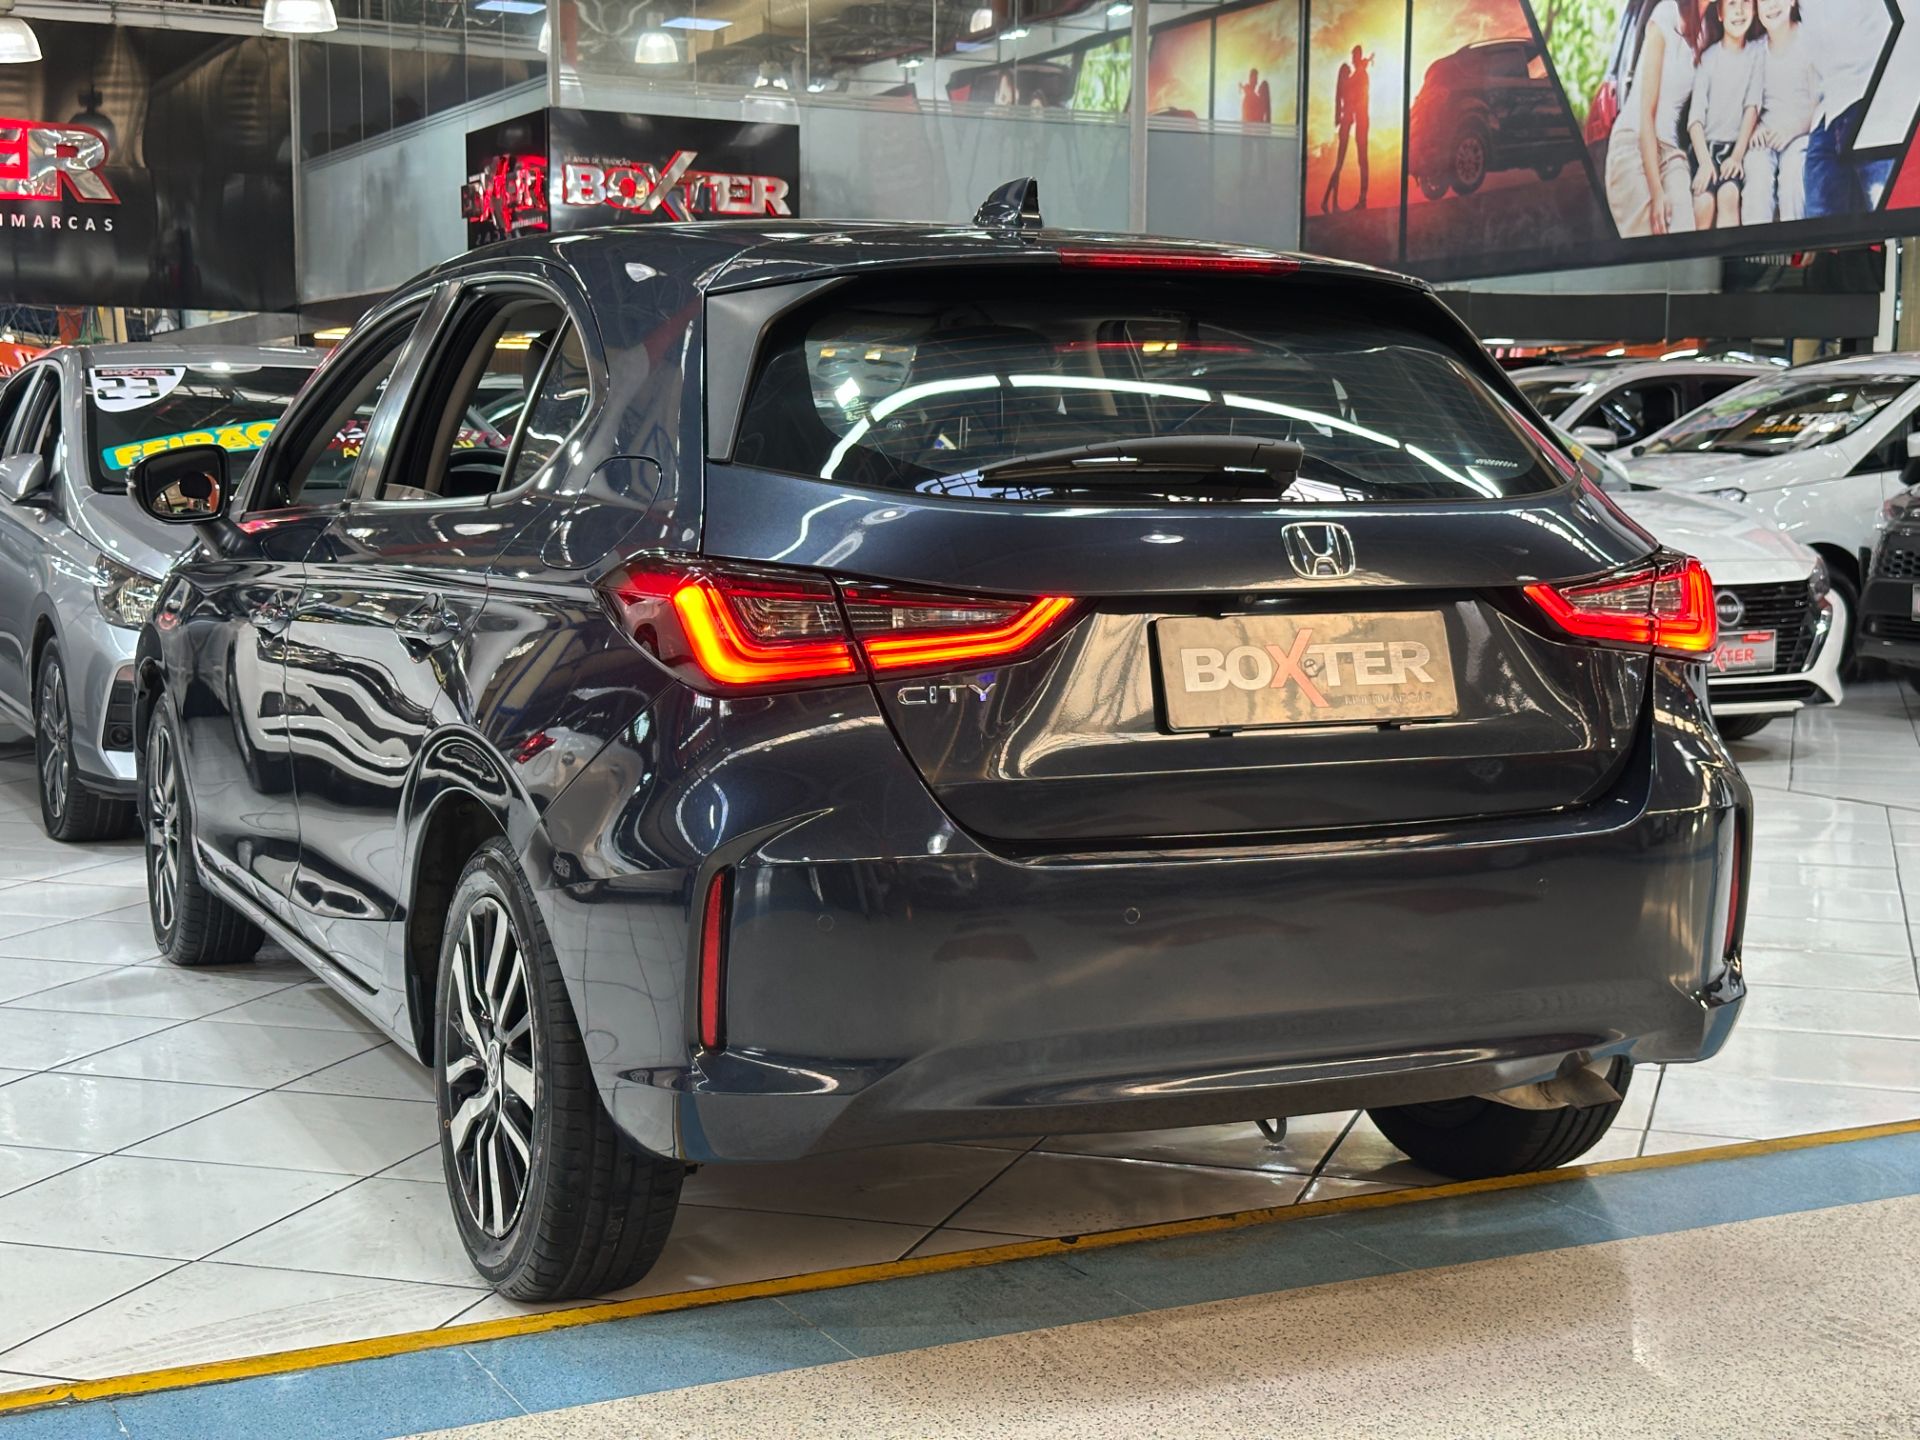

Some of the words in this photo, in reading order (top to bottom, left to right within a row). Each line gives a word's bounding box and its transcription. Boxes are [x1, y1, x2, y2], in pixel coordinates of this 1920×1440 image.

[562, 151, 792, 222] BOXTER
[897, 683, 996, 705] CITY
[1181, 628, 1435, 708] BOXTER
